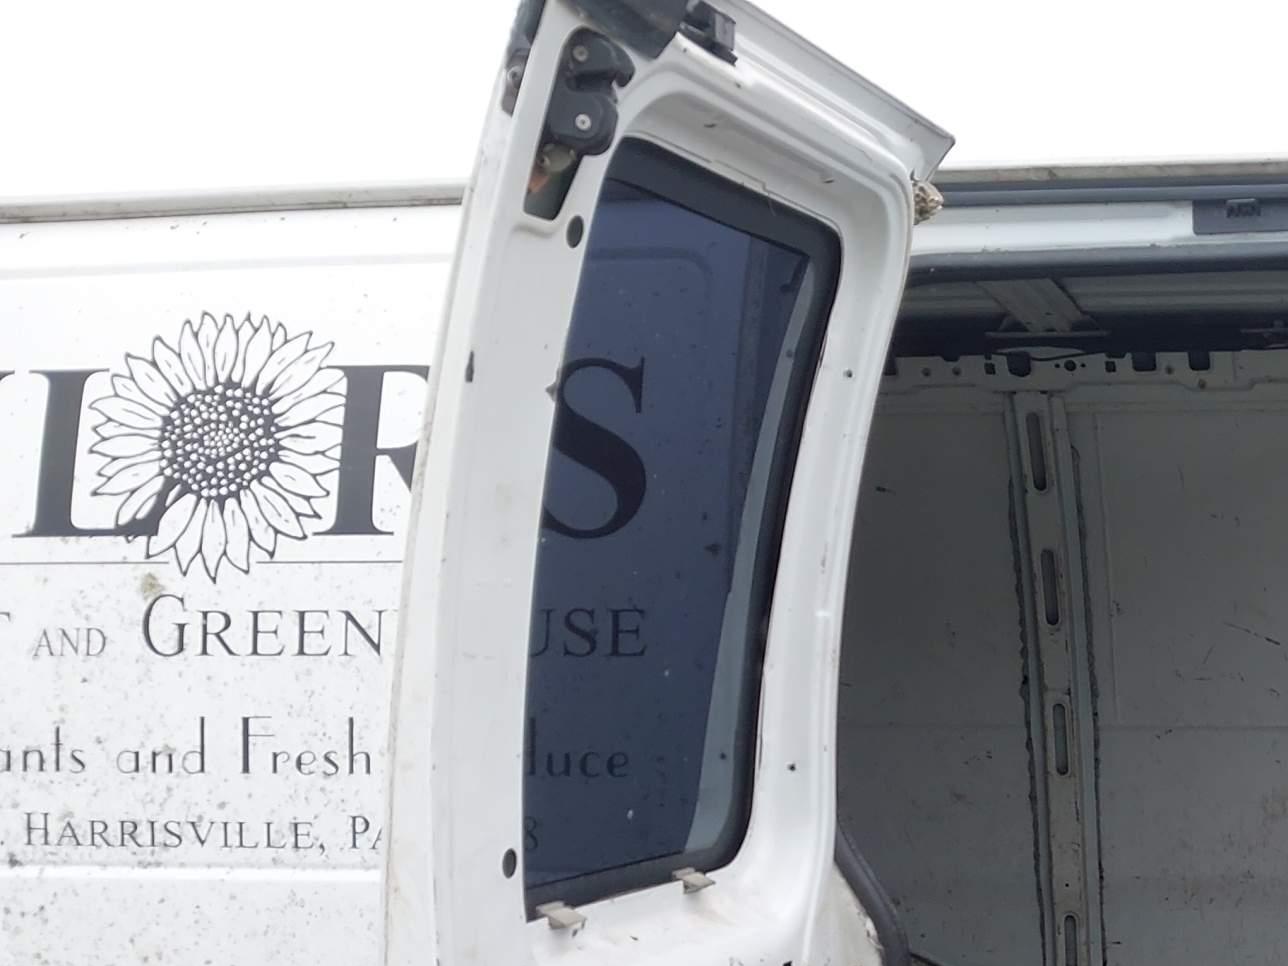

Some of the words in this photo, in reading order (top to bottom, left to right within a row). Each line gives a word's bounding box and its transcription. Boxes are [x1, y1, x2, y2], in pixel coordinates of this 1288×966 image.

[33, 627, 107, 657] AND
[142, 594, 648, 657] GREENUSE
[116, 717, 206, 774] and
[241, 716, 371, 776] Fresh
[25, 812, 326, 855] HARRISVILLE,
